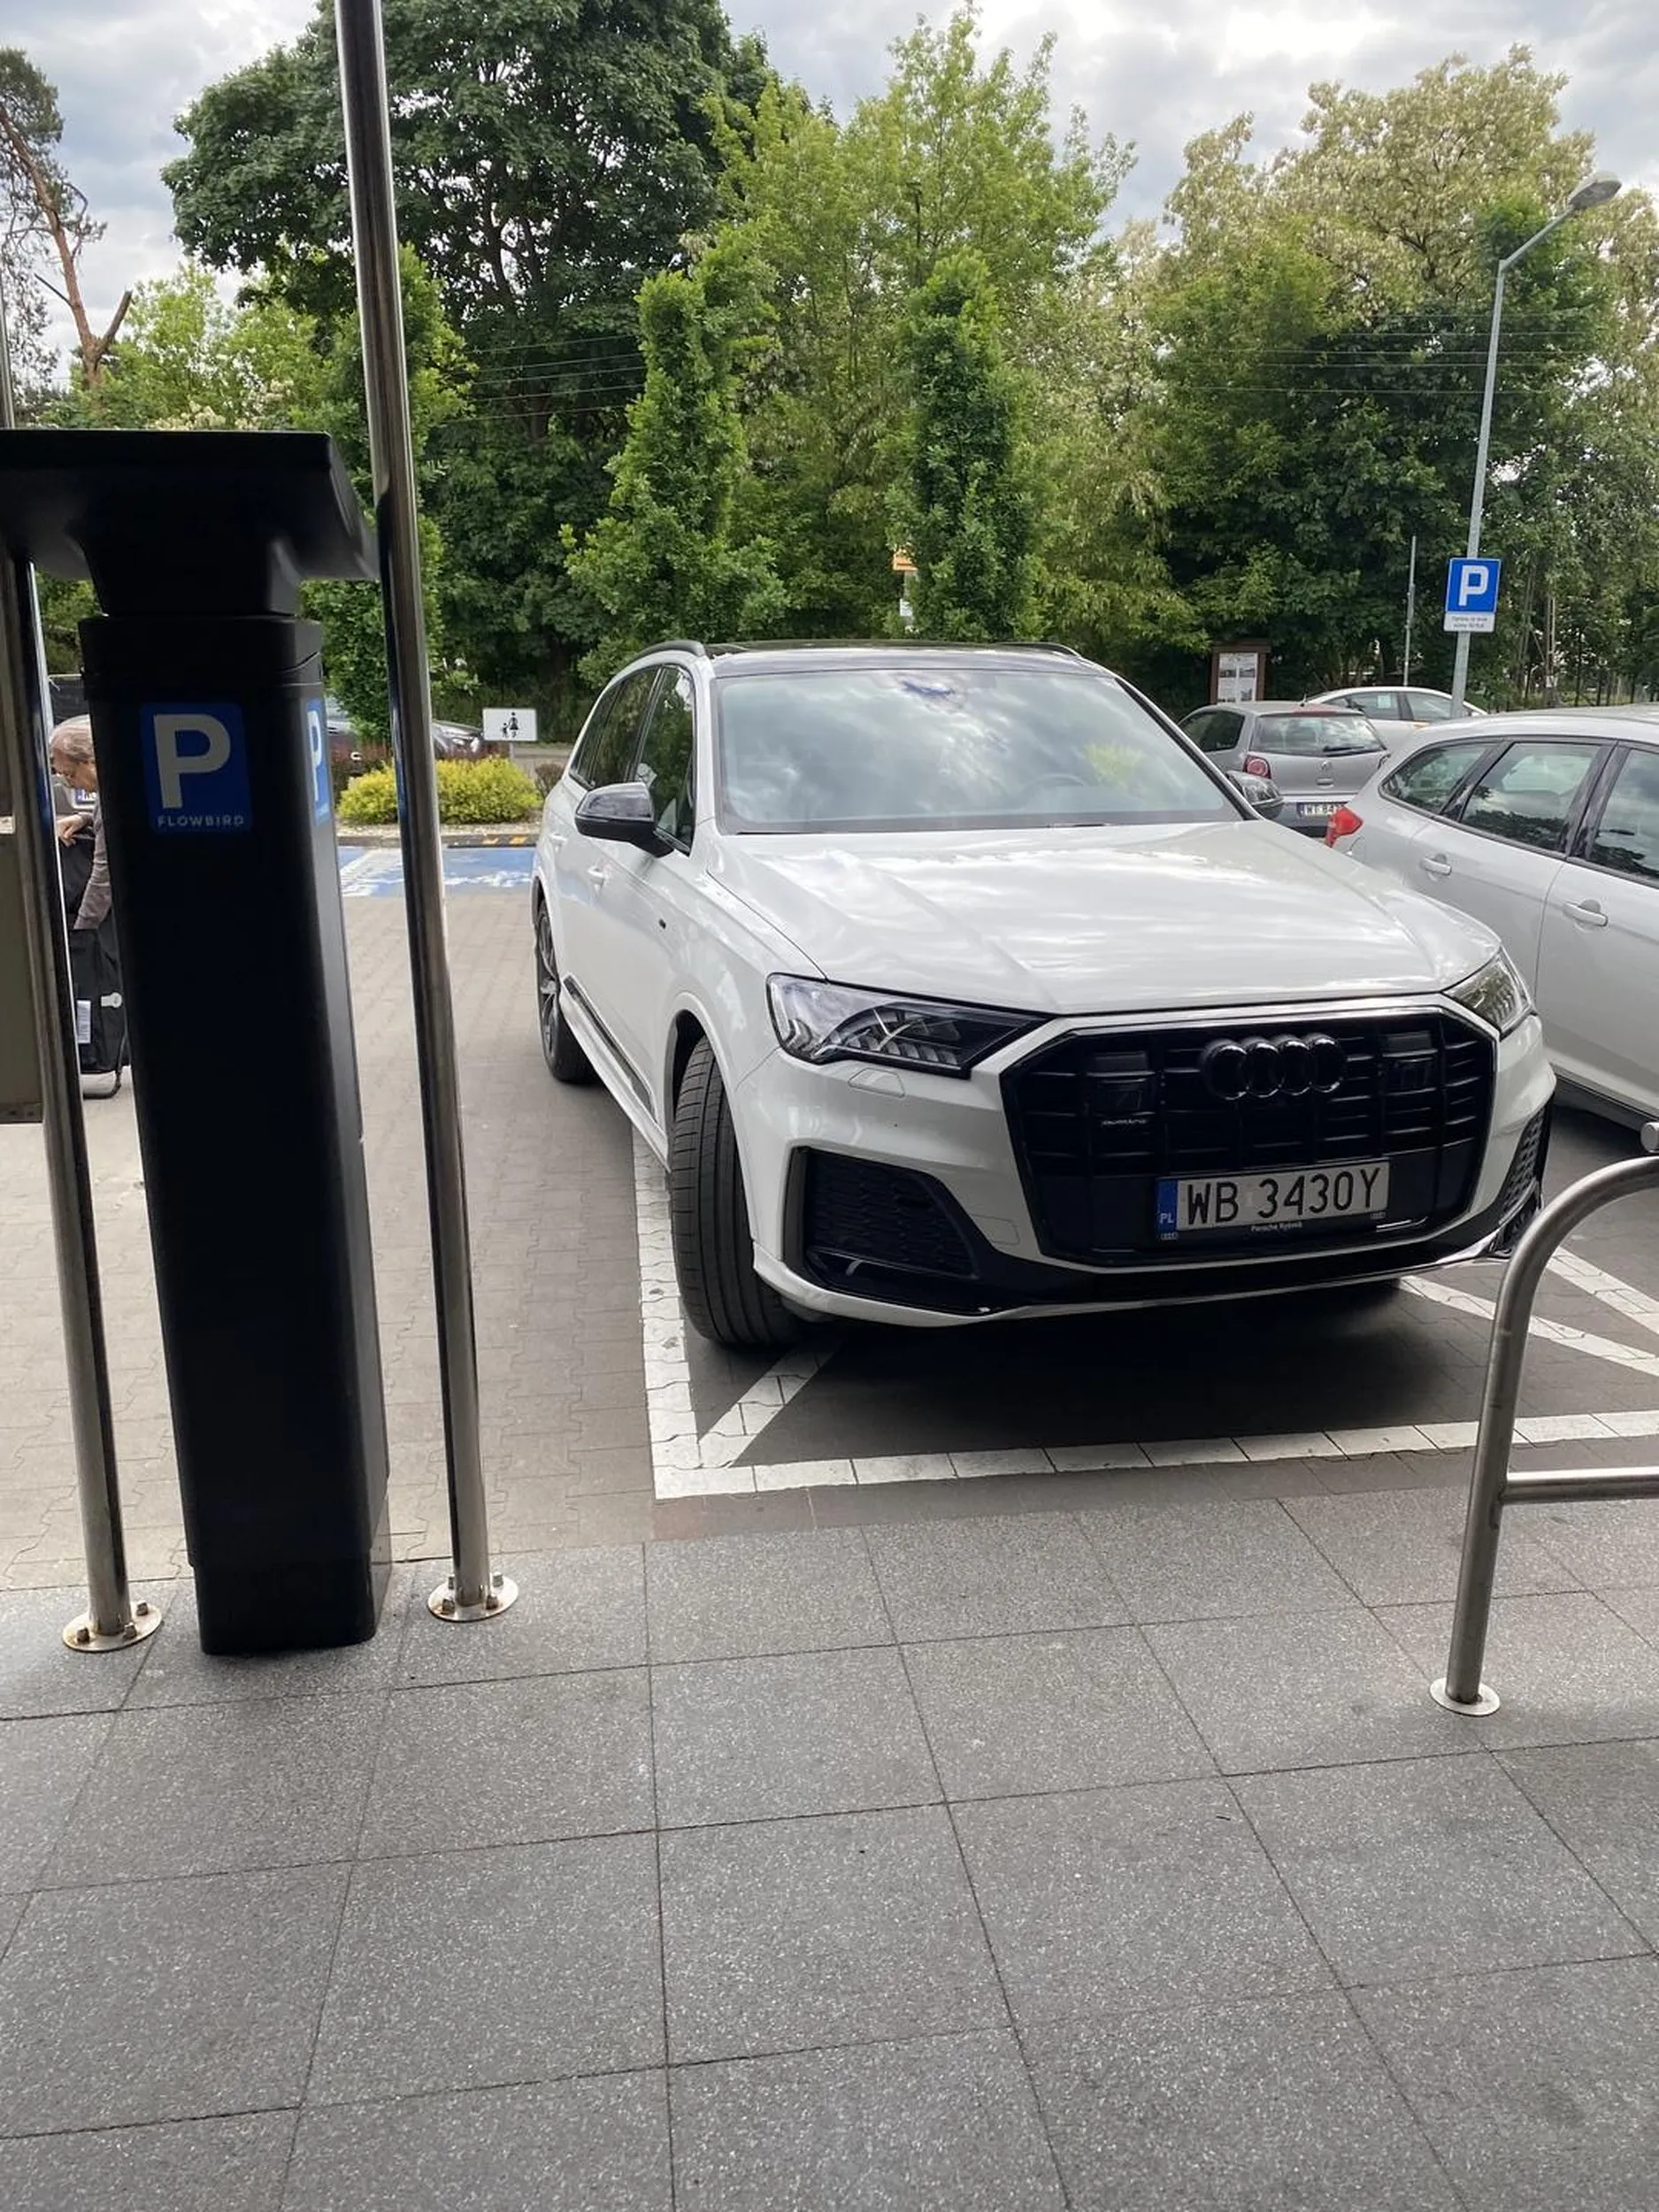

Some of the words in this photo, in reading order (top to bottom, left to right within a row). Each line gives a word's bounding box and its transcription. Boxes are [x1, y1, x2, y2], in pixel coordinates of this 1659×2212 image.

[1458, 565, 1489, 606] P
[154, 713, 230, 809] P
[307, 710, 322, 802] P
[157, 814, 244, 828] FLOWBIRD
[1159, 1213, 1175, 1224] PL
[1187, 1181, 1239, 1225] WB
[1257, 1167, 1380, 1219] 3430Y
